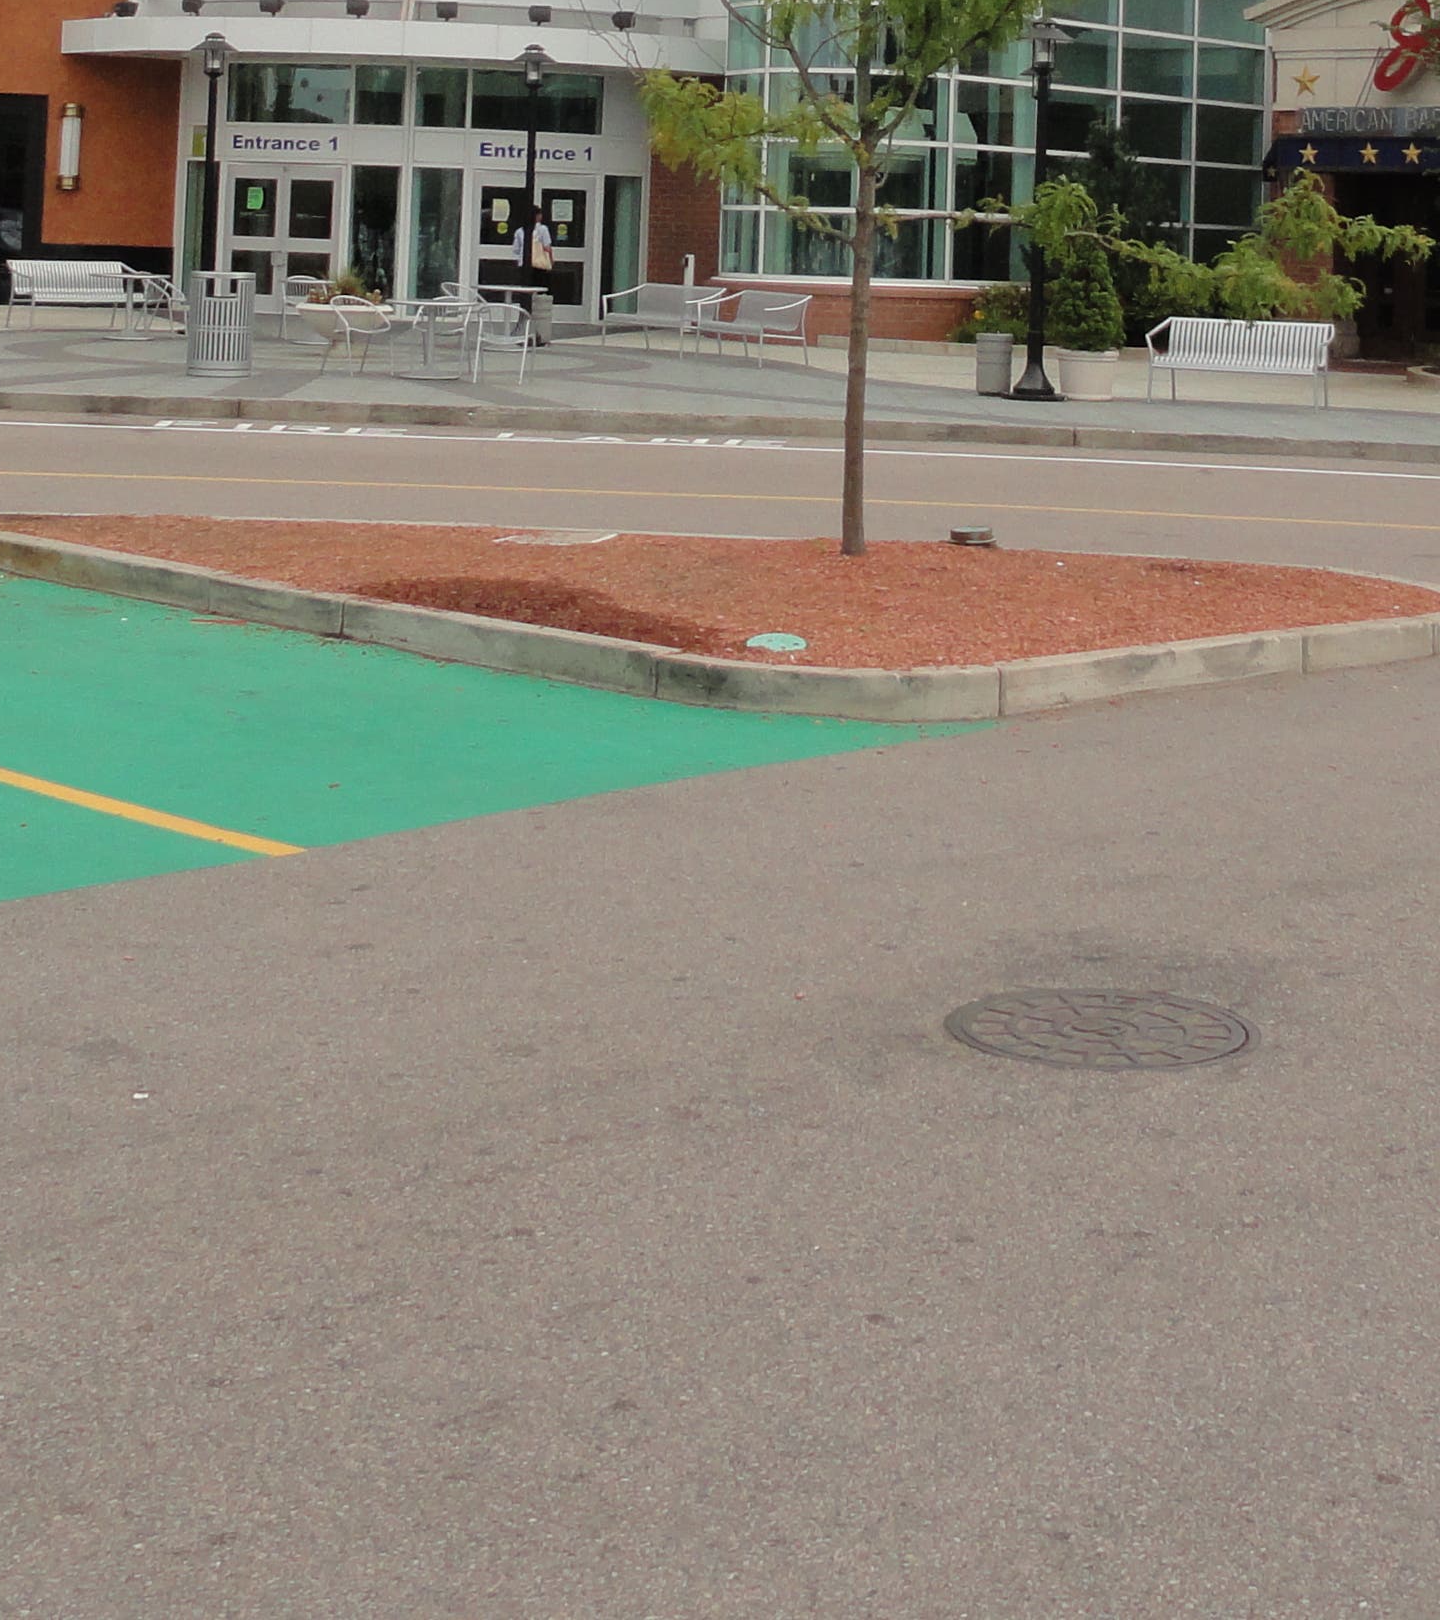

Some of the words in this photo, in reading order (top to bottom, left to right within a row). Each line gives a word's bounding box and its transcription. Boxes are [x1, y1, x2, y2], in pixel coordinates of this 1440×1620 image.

[1301, 108, 1393, 131] AMERICAN
[232, 134, 321, 151] Entrance
[328, 136, 338, 151] 1
[480, 142, 576, 161] Entrnce
[584, 146, 593, 161] 1
